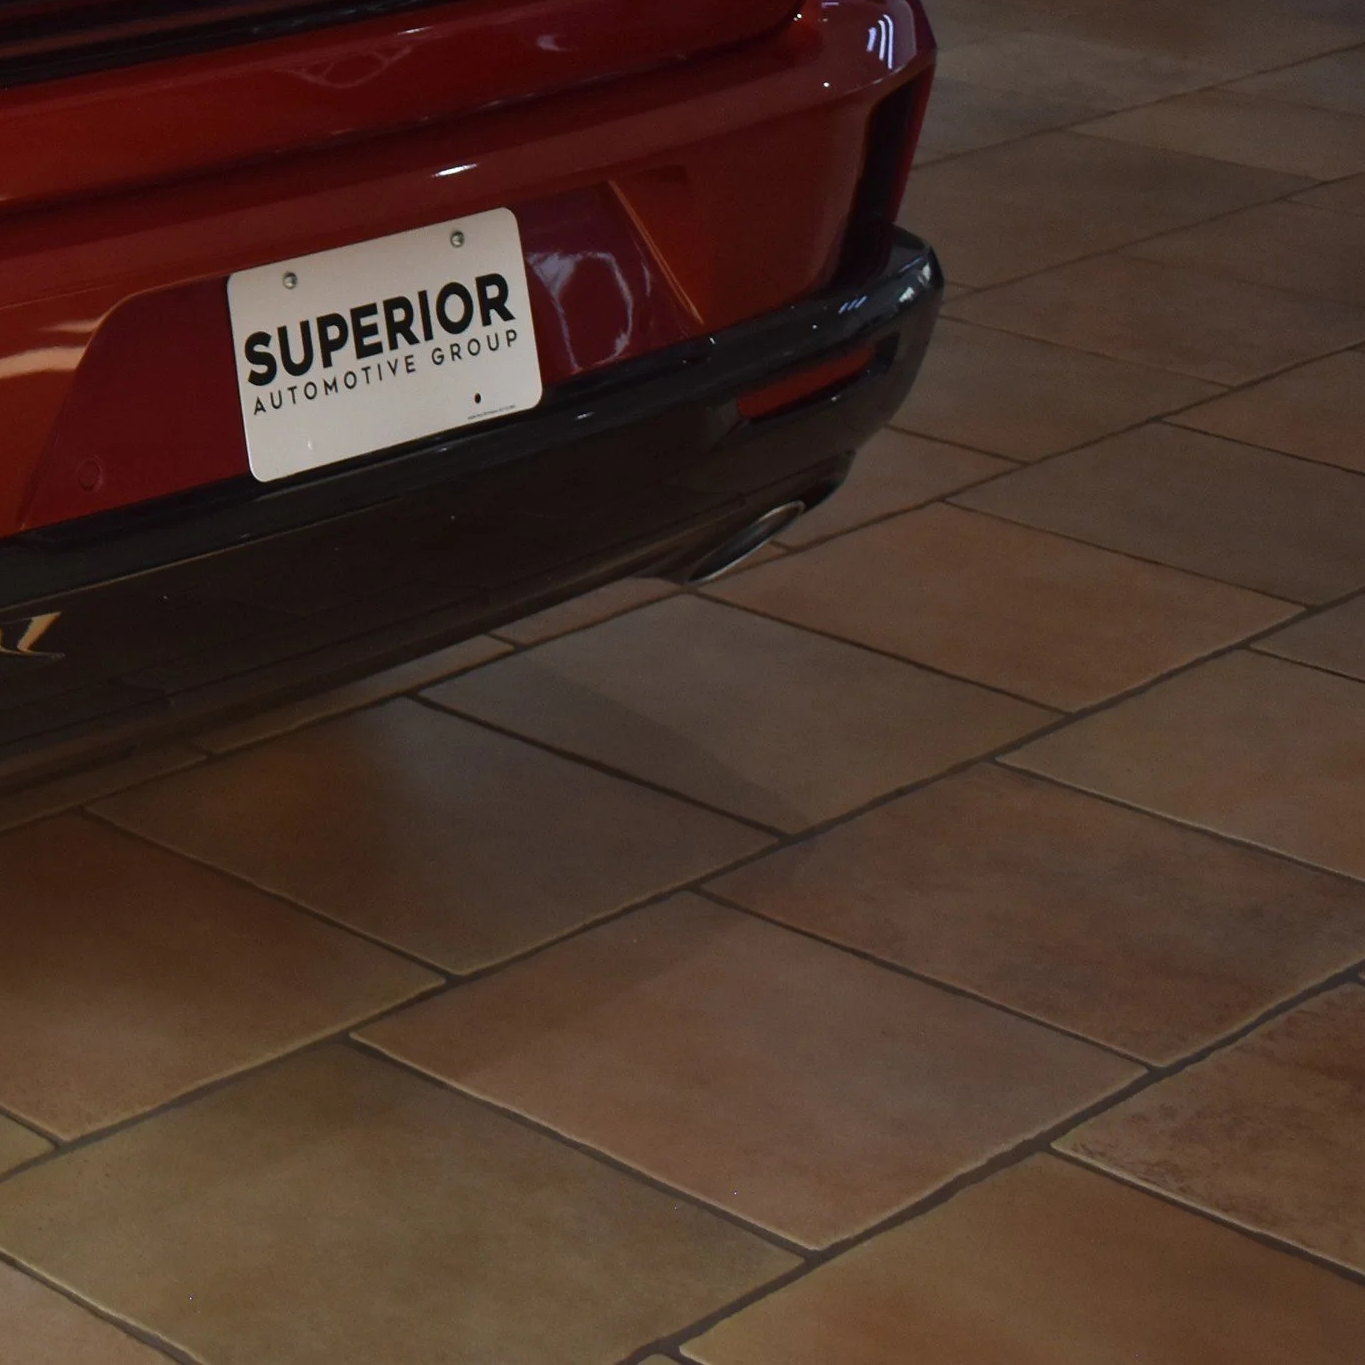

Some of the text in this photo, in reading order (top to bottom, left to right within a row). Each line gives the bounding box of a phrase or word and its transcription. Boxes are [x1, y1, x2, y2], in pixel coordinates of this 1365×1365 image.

[243, 272, 517, 388] SUPERIOR
[252, 328, 519, 417] AUTOMOTIVE GROUP
